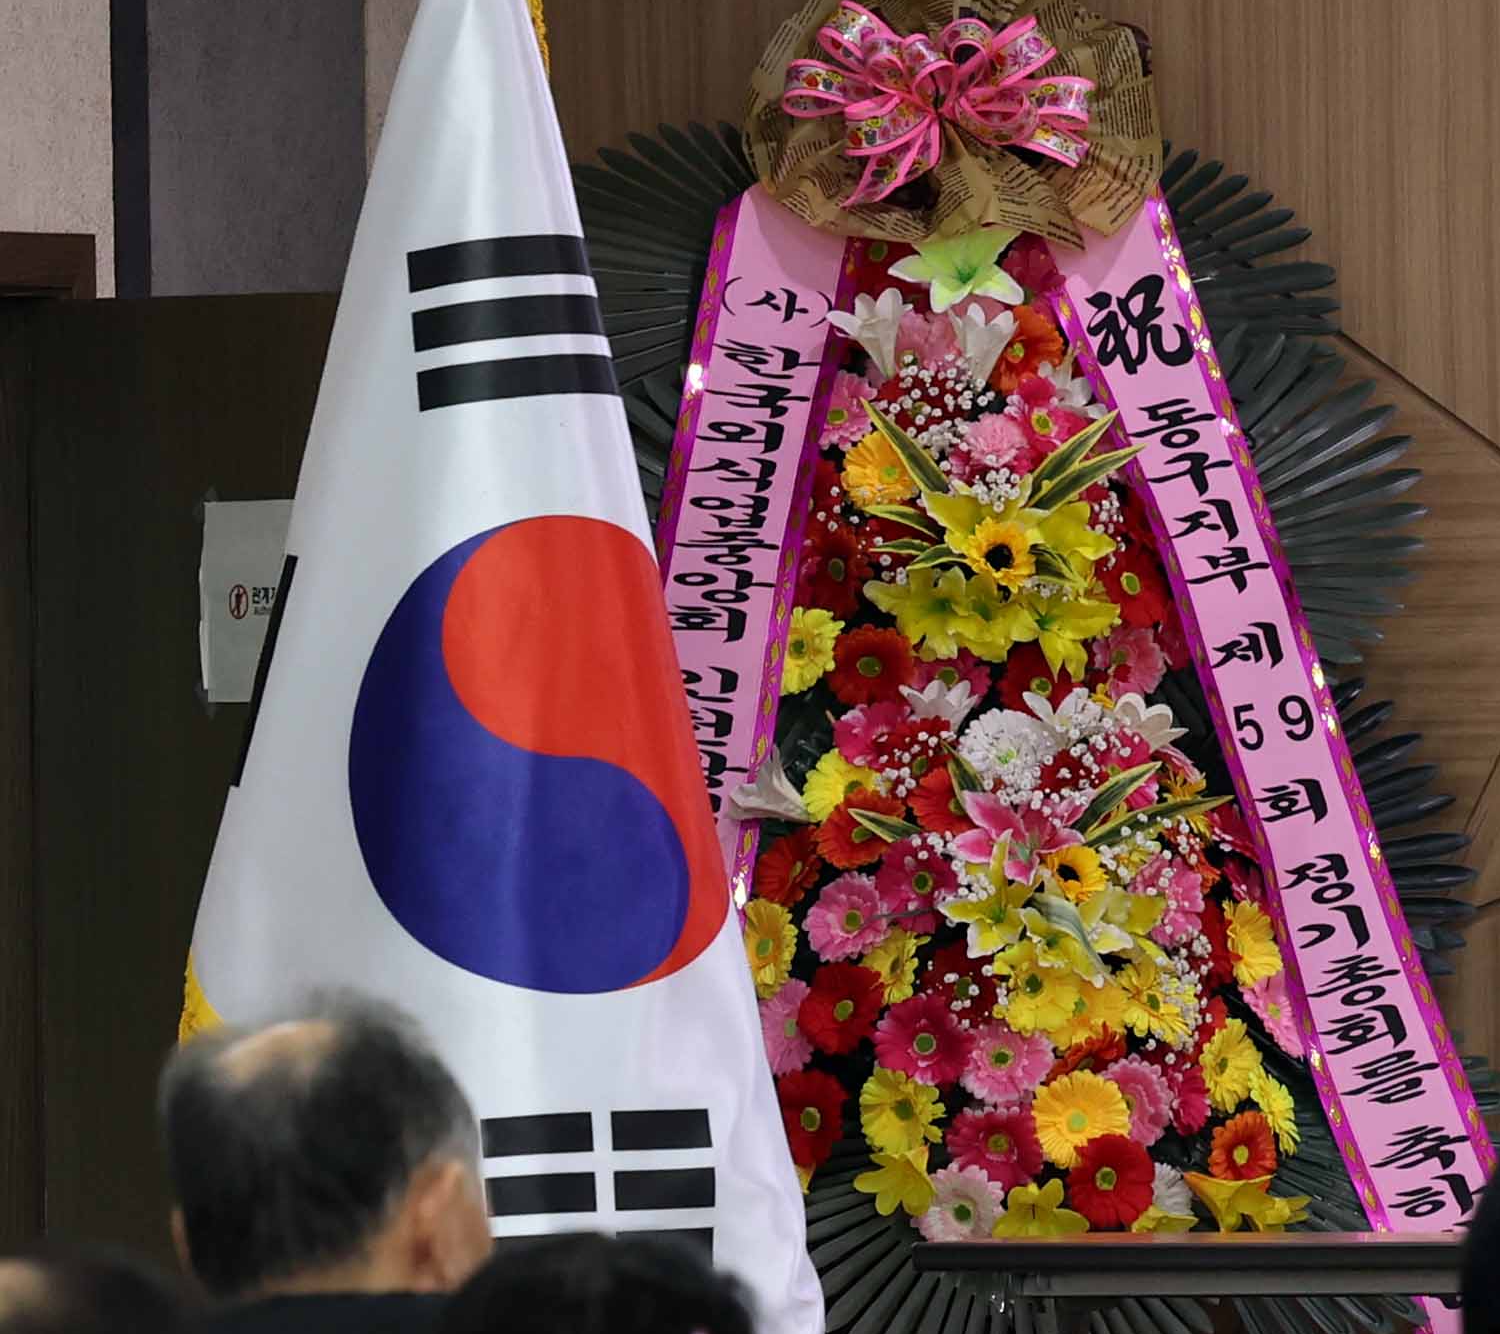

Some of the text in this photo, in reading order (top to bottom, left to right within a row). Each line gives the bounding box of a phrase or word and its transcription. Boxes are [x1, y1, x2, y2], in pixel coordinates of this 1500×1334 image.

[1087, 273, 1197, 375] 祝
[1128, 397, 1271, 595] 동구지부
[1281, 854, 1440, 1104] 정기총회를
